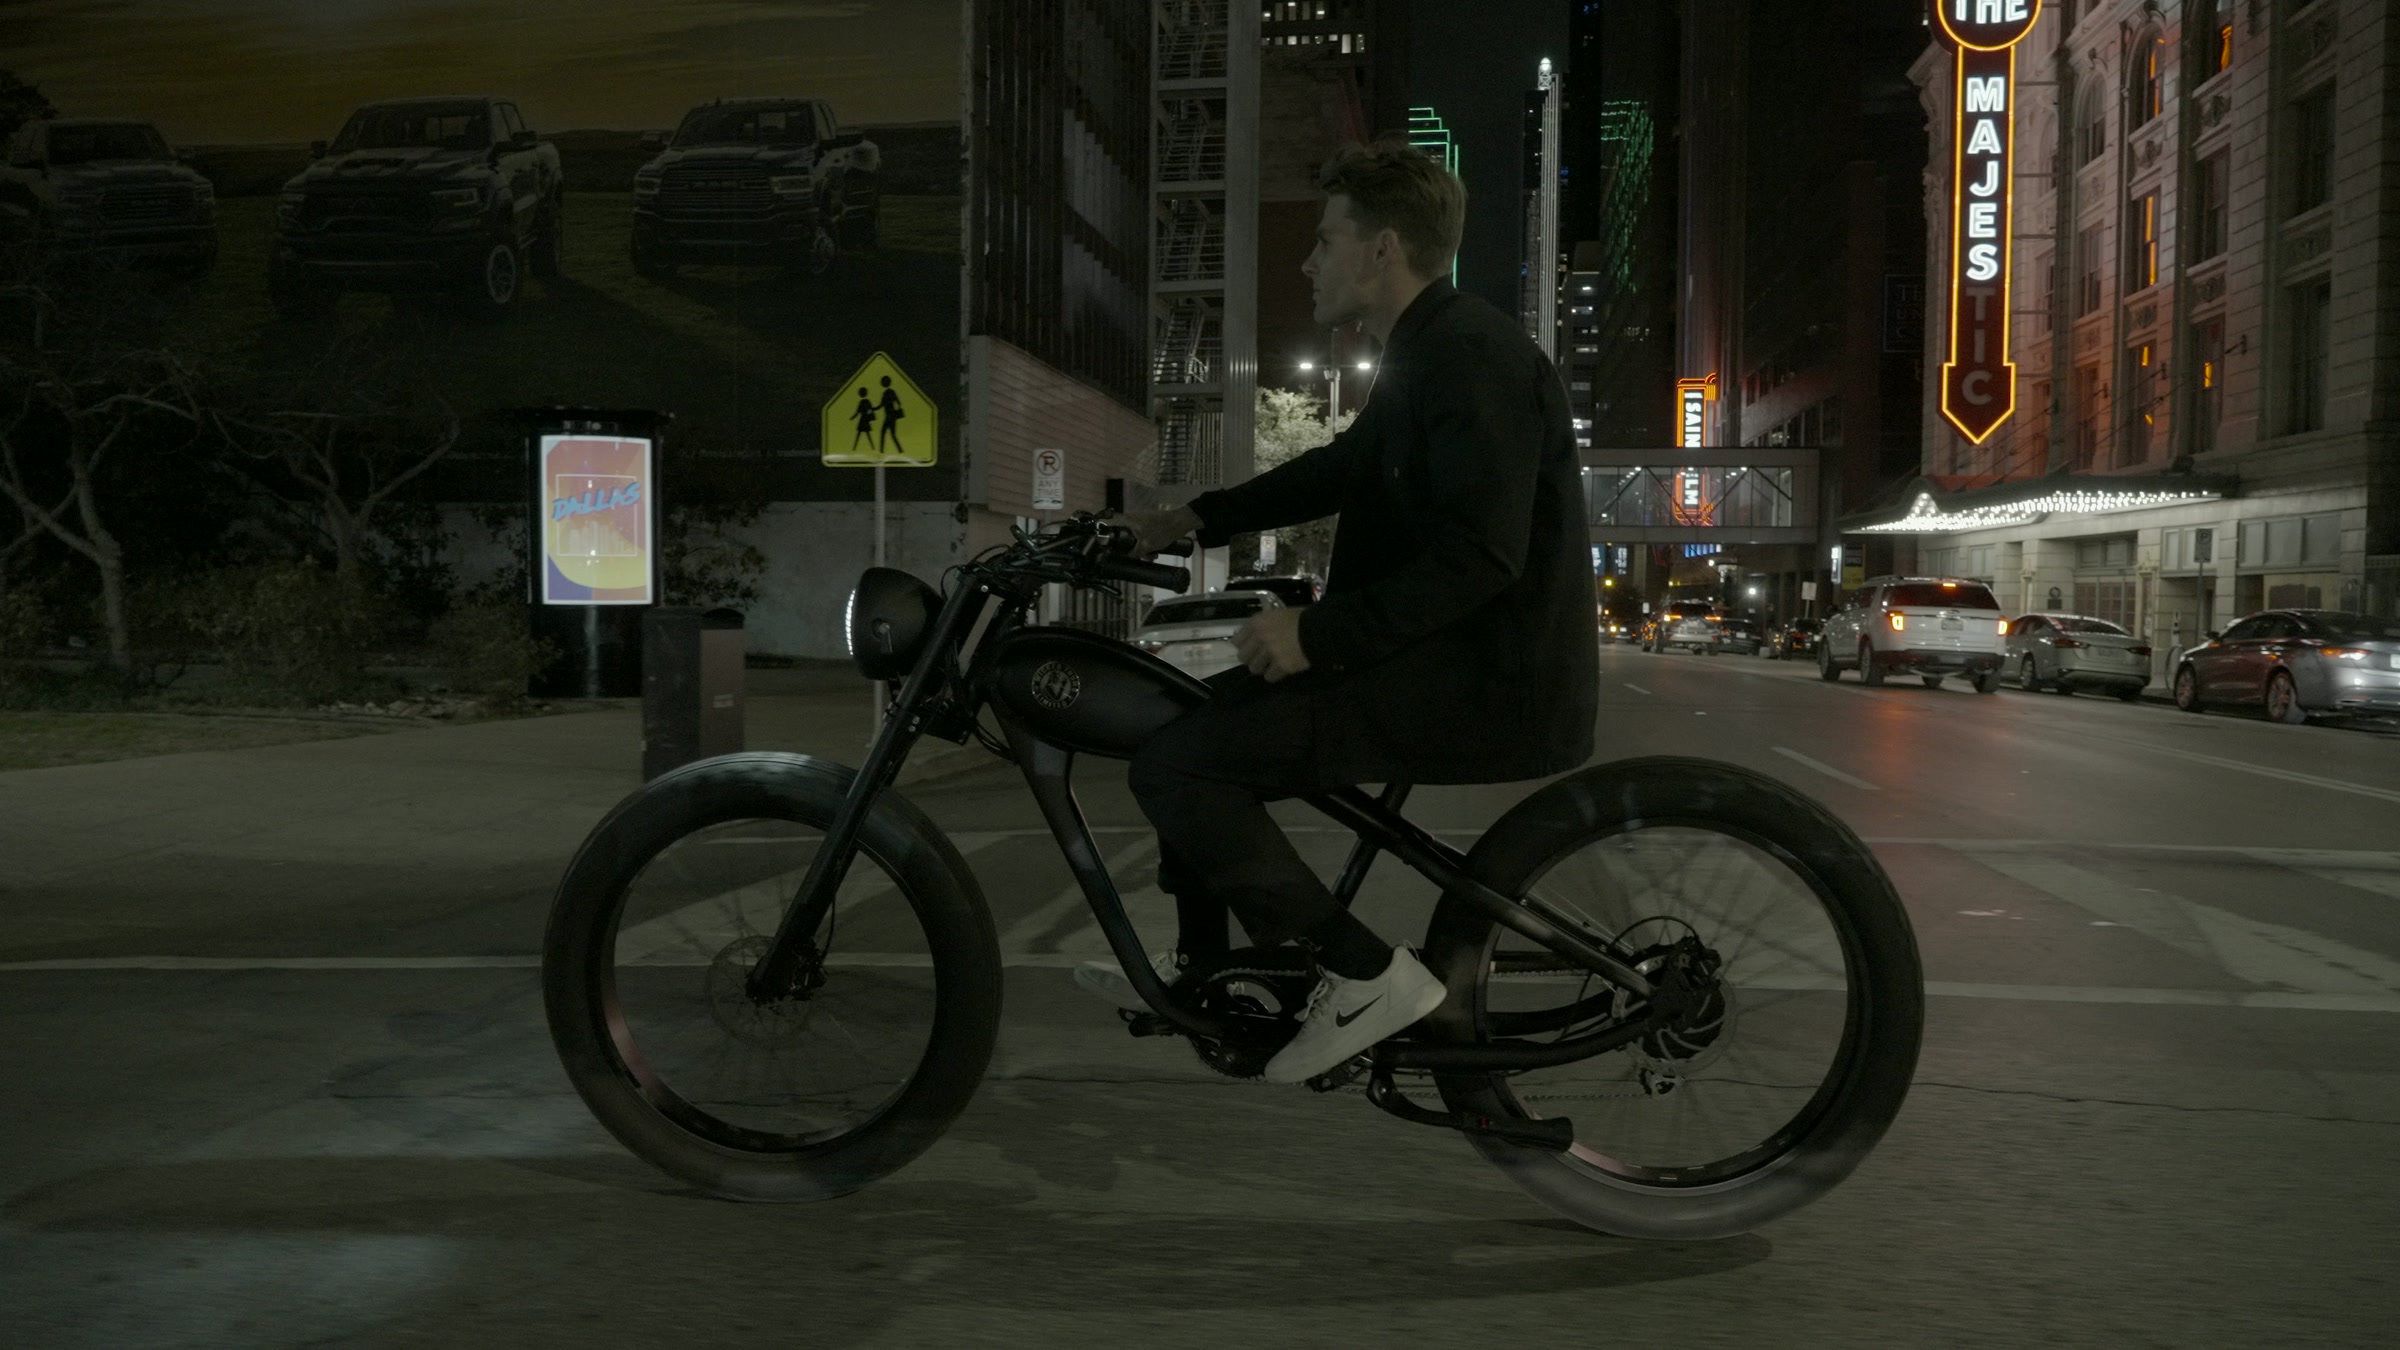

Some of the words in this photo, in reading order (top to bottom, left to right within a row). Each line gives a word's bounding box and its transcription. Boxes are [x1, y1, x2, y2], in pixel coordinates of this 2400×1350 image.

[1962, 77, 2005, 406] MAJESTIC
[1684, 402, 1702, 448] SAIN
[552, 481, 640, 522] DALLAS
[1037, 488, 1059, 497] TIME
